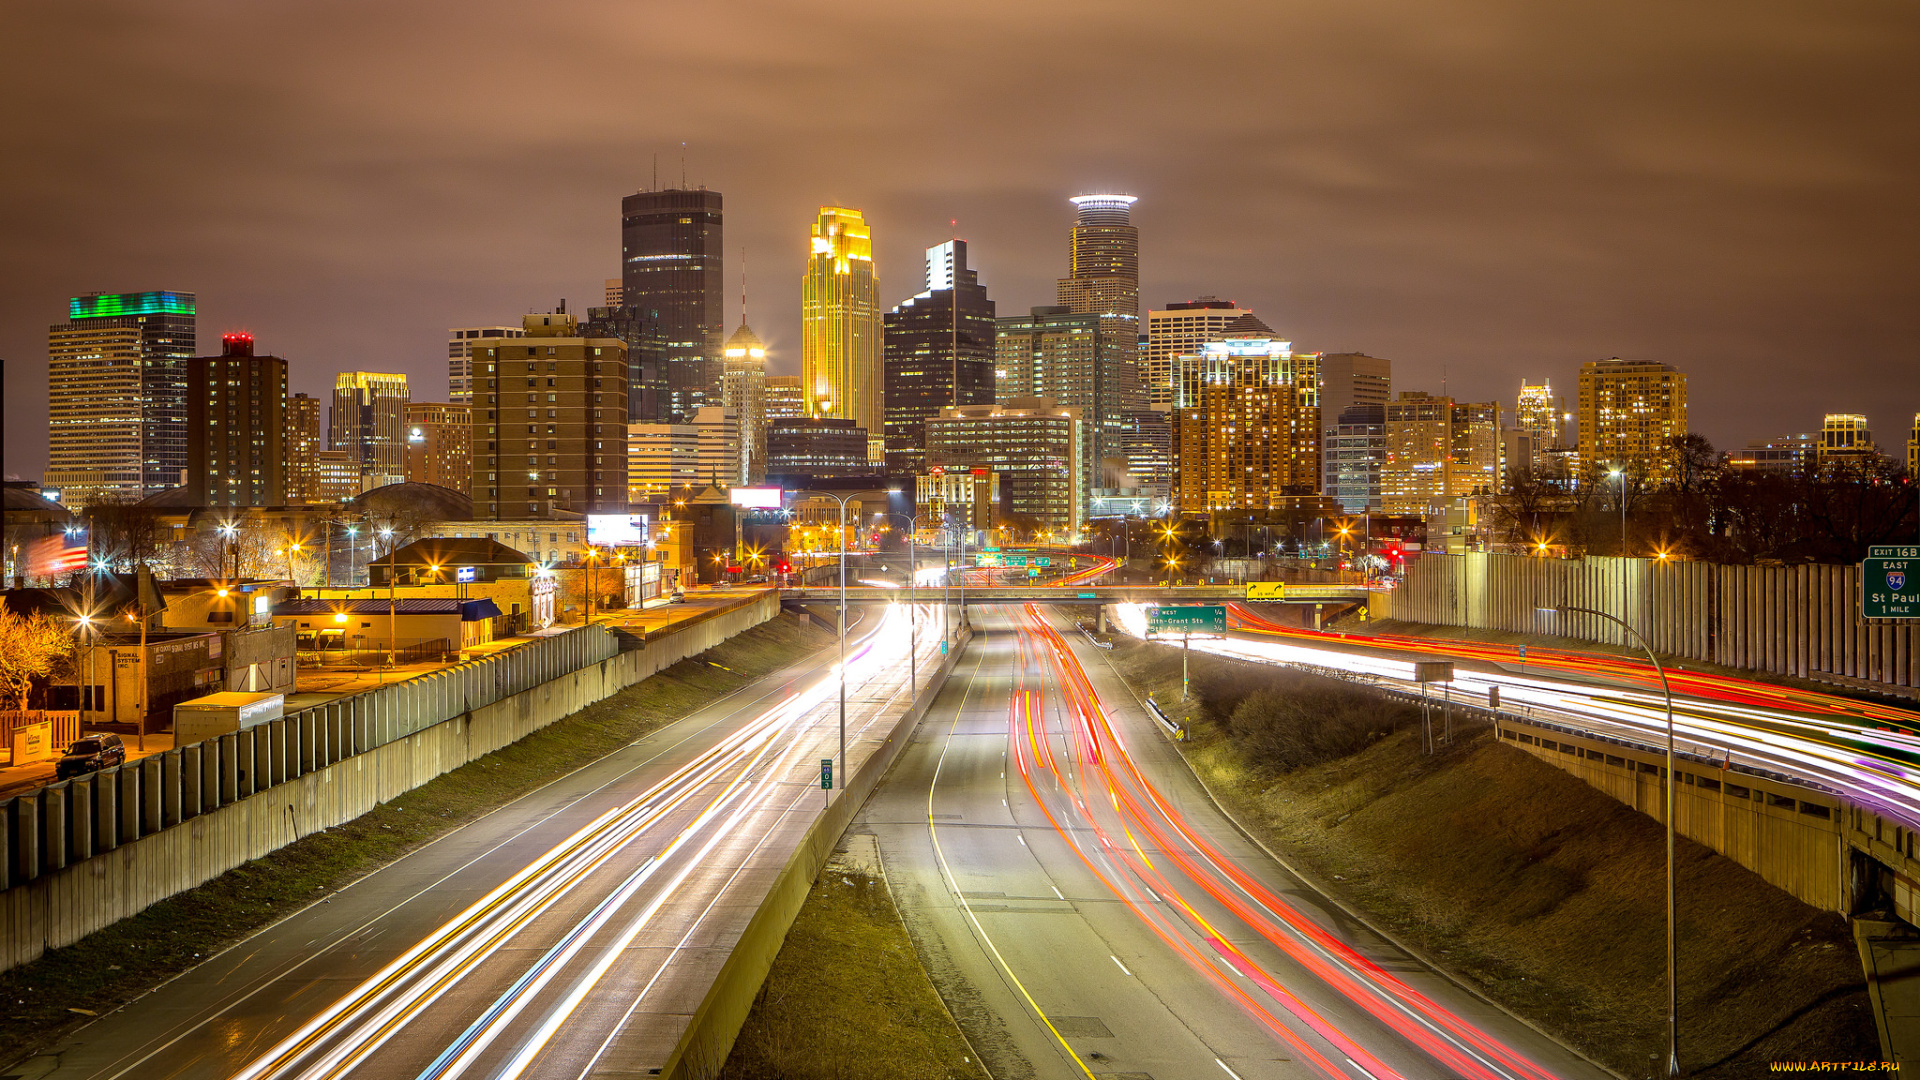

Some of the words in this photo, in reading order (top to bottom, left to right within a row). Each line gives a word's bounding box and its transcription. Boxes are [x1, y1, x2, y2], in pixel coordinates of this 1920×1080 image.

[1897, 548, 1917, 556] 16B
[1889, 576, 1902, 585] 94
[1872, 593, 1885, 602] St
[1892, 593, 1920, 602] Paul
[1882, 605, 1886, 613] 1
